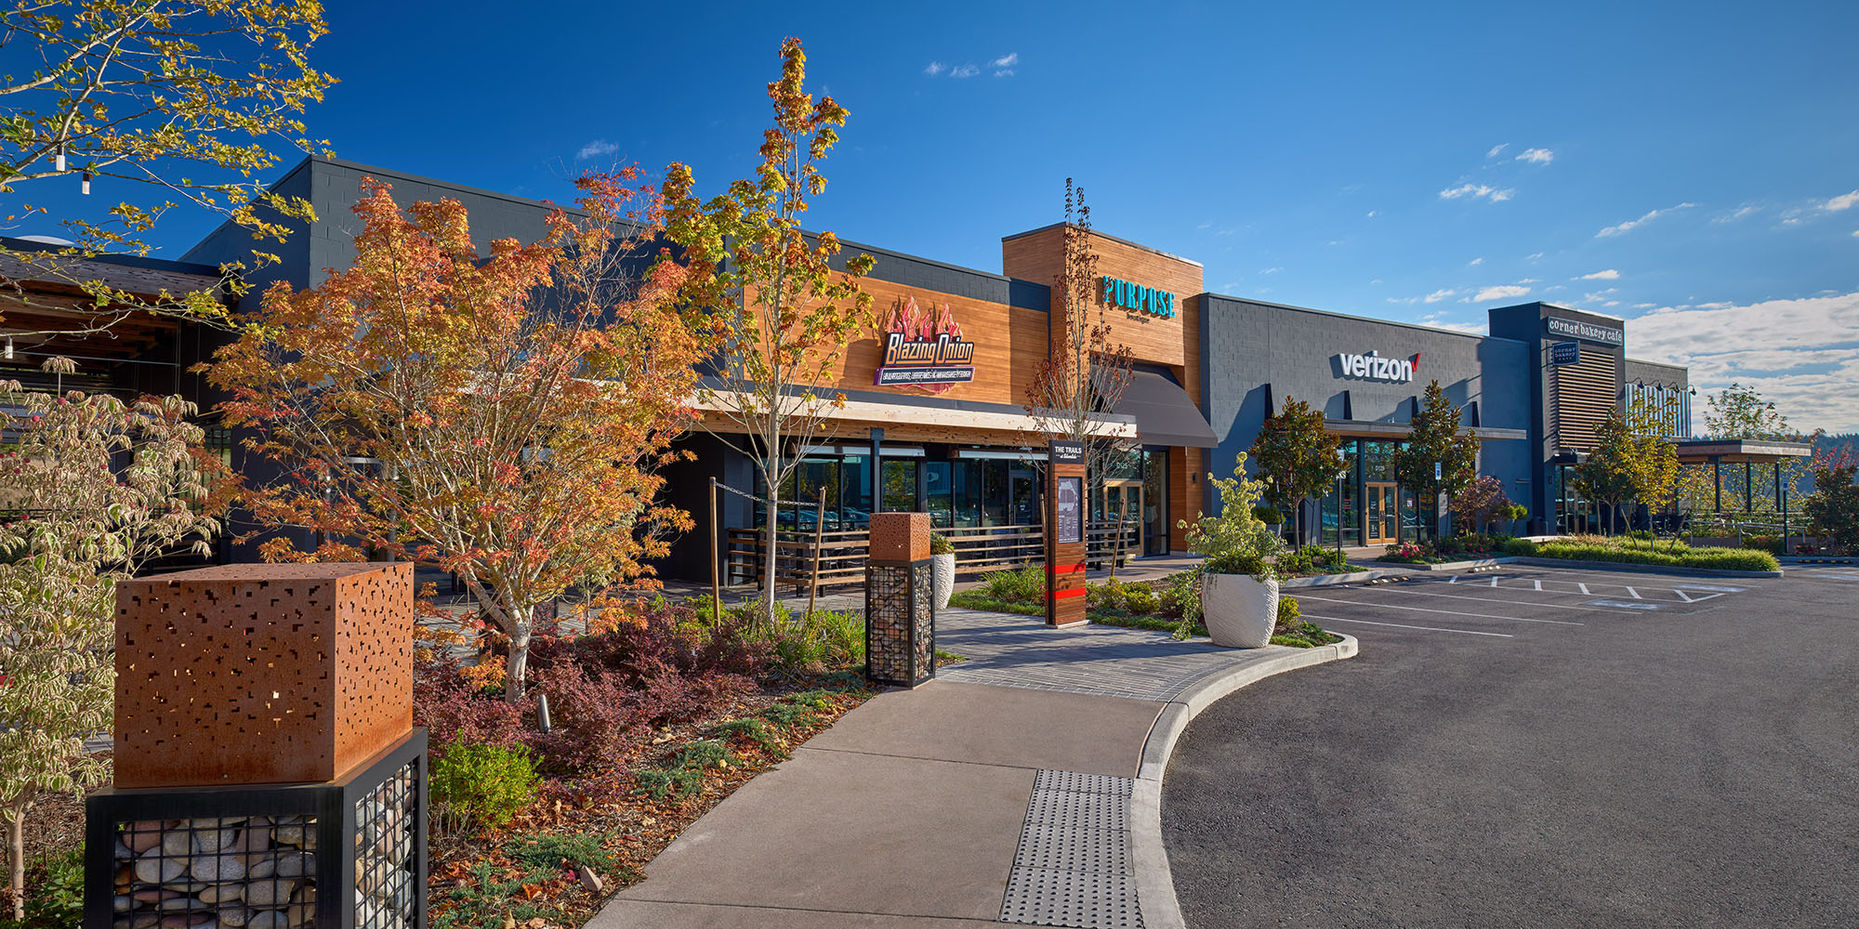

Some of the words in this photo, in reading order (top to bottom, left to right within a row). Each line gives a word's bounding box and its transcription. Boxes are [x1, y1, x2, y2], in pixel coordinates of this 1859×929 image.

[1103, 275, 1176, 317] PURPOSE
[1549, 320, 1579, 334] corner
[1580, 324, 1607, 340] bakery
[1606, 330, 1622, 342] cafe
[885, 333, 937, 365] Blazing
[935, 333, 974, 364] Onion
[1340, 350, 1413, 382] verizon
[1065, 446, 1082, 454] TRAILS
